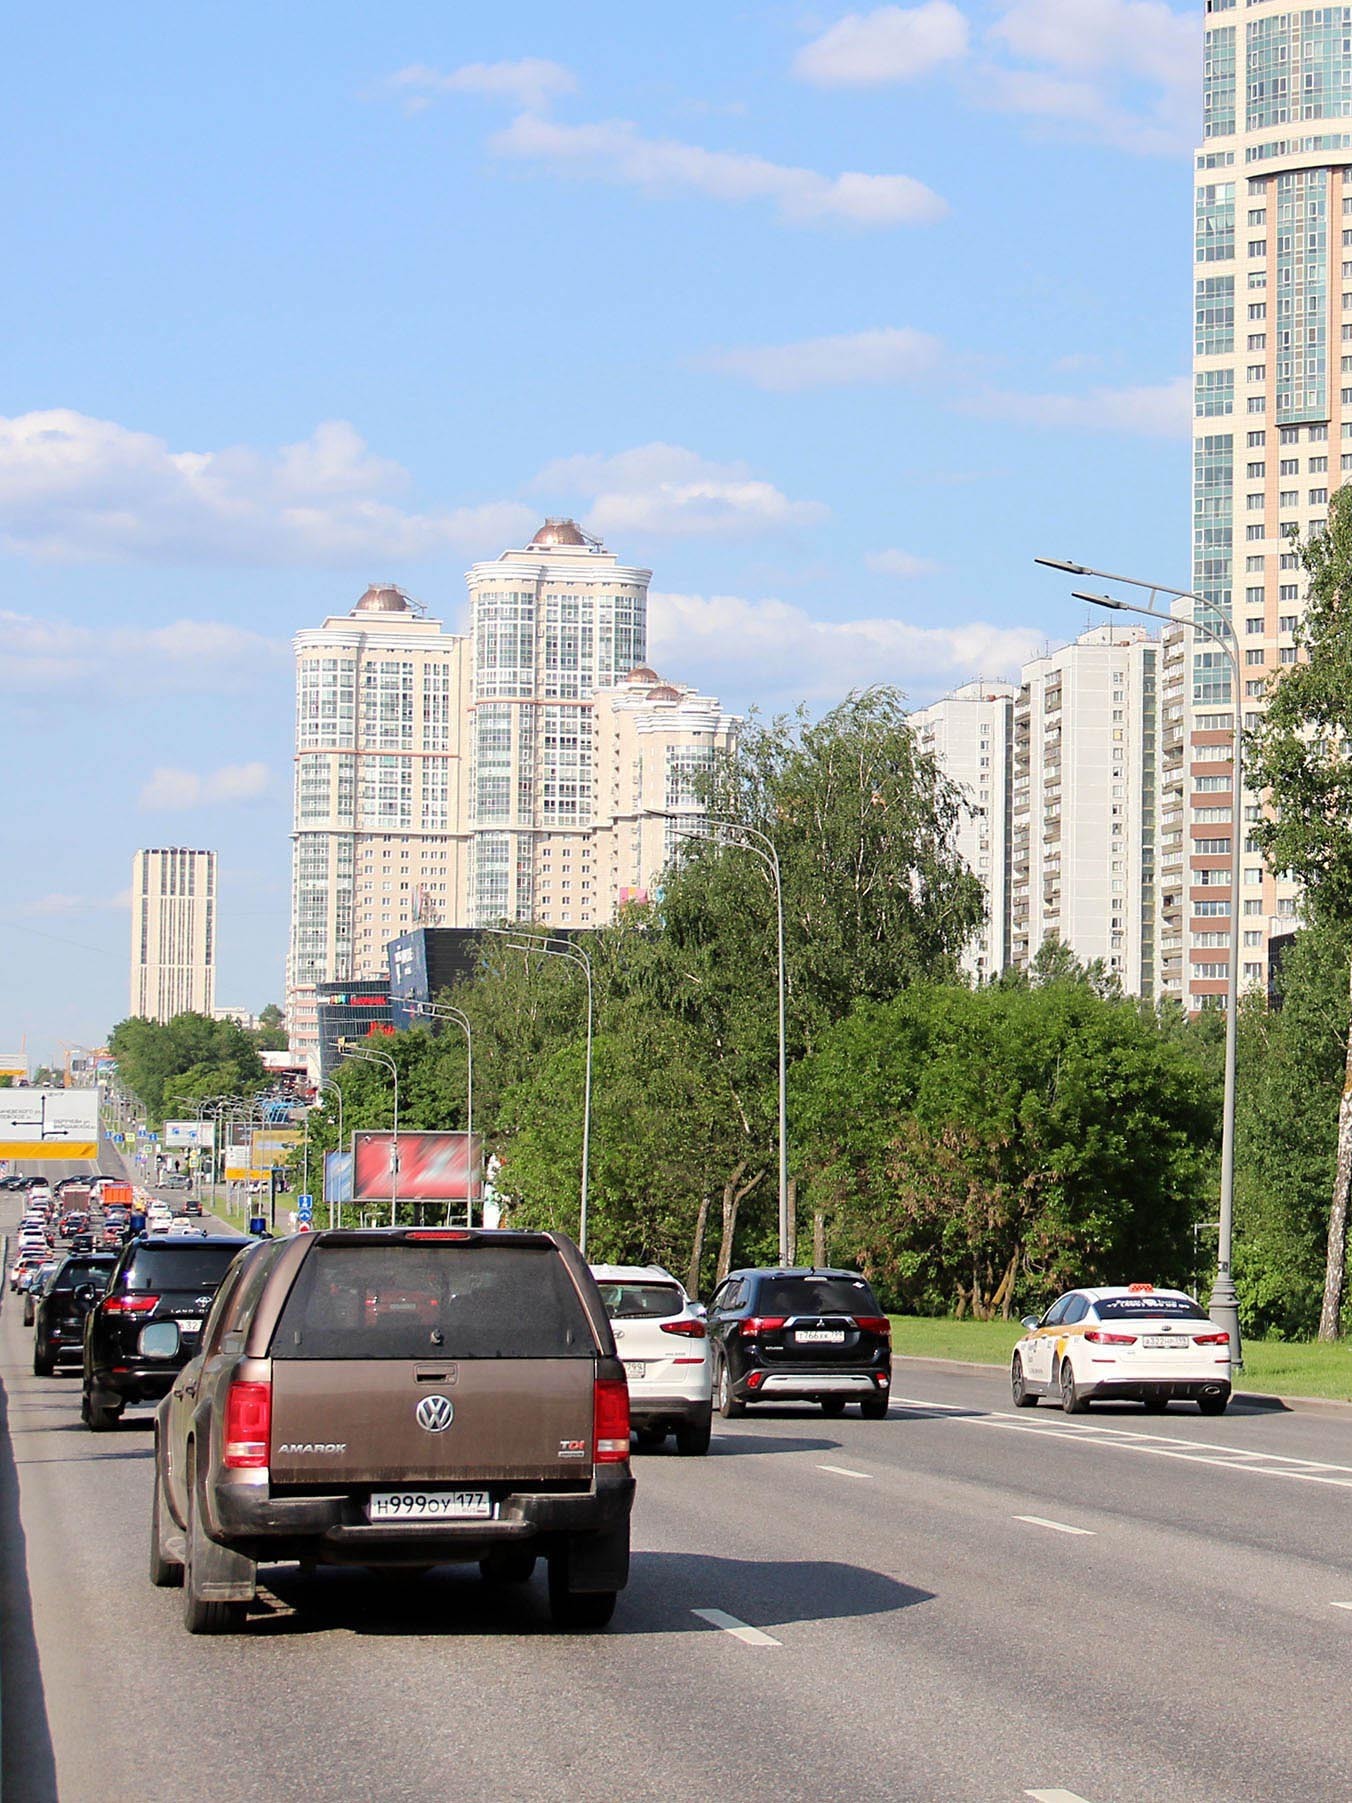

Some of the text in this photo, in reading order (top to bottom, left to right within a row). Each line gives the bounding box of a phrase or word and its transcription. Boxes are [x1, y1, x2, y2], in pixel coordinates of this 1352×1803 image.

[278, 1442, 347, 1454] AMAROK
[560, 1440, 586, 1450] TDI
[457, 1493, 484, 1508] 177
